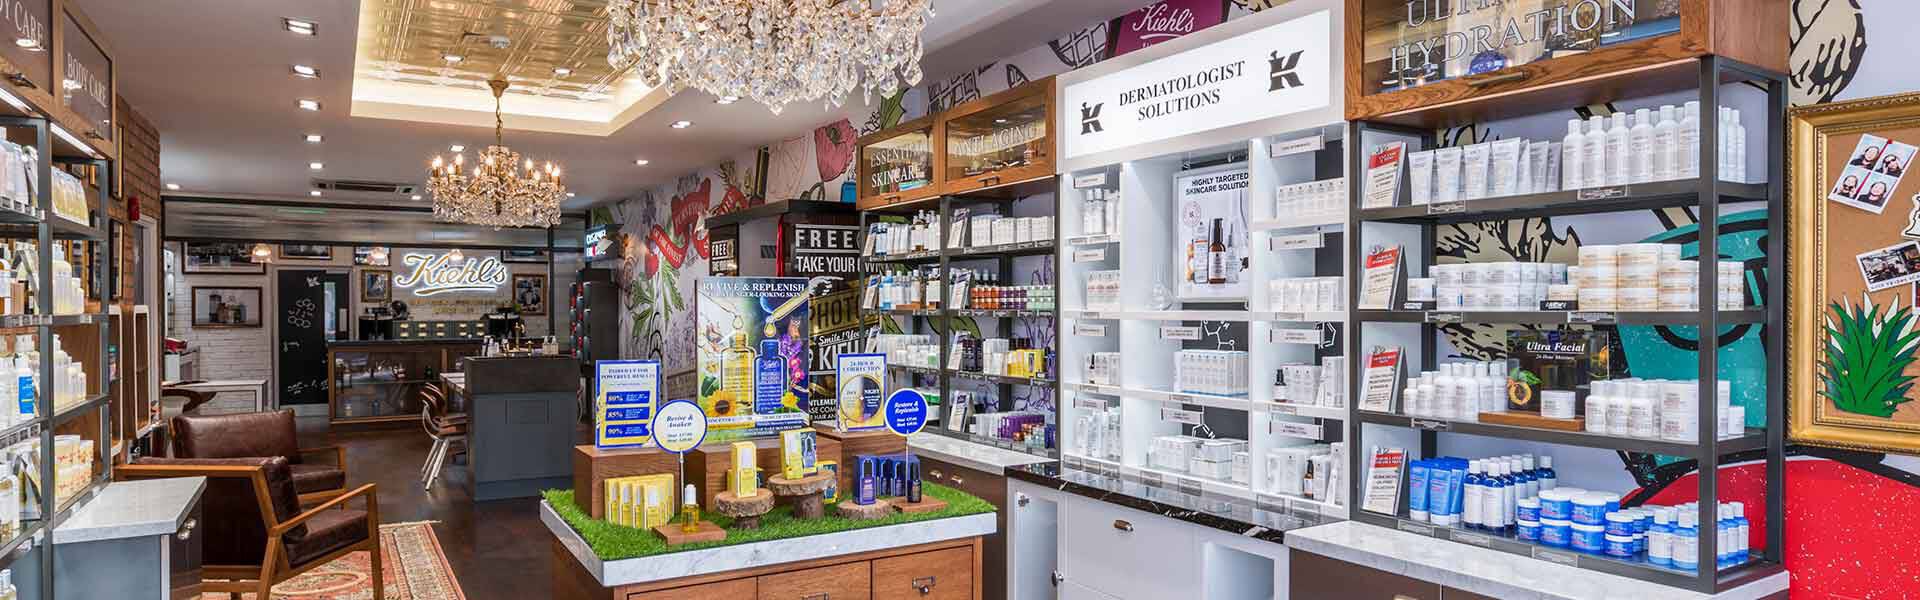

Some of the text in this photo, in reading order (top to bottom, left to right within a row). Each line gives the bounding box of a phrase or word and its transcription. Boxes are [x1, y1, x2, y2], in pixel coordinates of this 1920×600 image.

[1132, 3, 1195, 32] Kiehl's
[1391, 0, 1636, 74] HYDRATION
[1119, 60, 1246, 107] DERMATOLOGIST
[1138, 88, 1221, 121] SOLUTIONS
[870, 142, 928, 169] ESSENTI
[1185, 184, 1217, 195] SKINCARE
[1192, 172, 1249, 187] HIGHLY TARGETED
[795, 229, 854, 249] FREE
[711, 241, 728, 258] FREE
[395, 253, 507, 287] Kiehl's
[796, 256, 824, 273] TAKE
[826, 257, 855, 273] YOUR
[743, 283, 750, 291] &
[752, 282, 805, 292] REPLENISH
[1527, 341, 1585, 352] Ultra Facial
